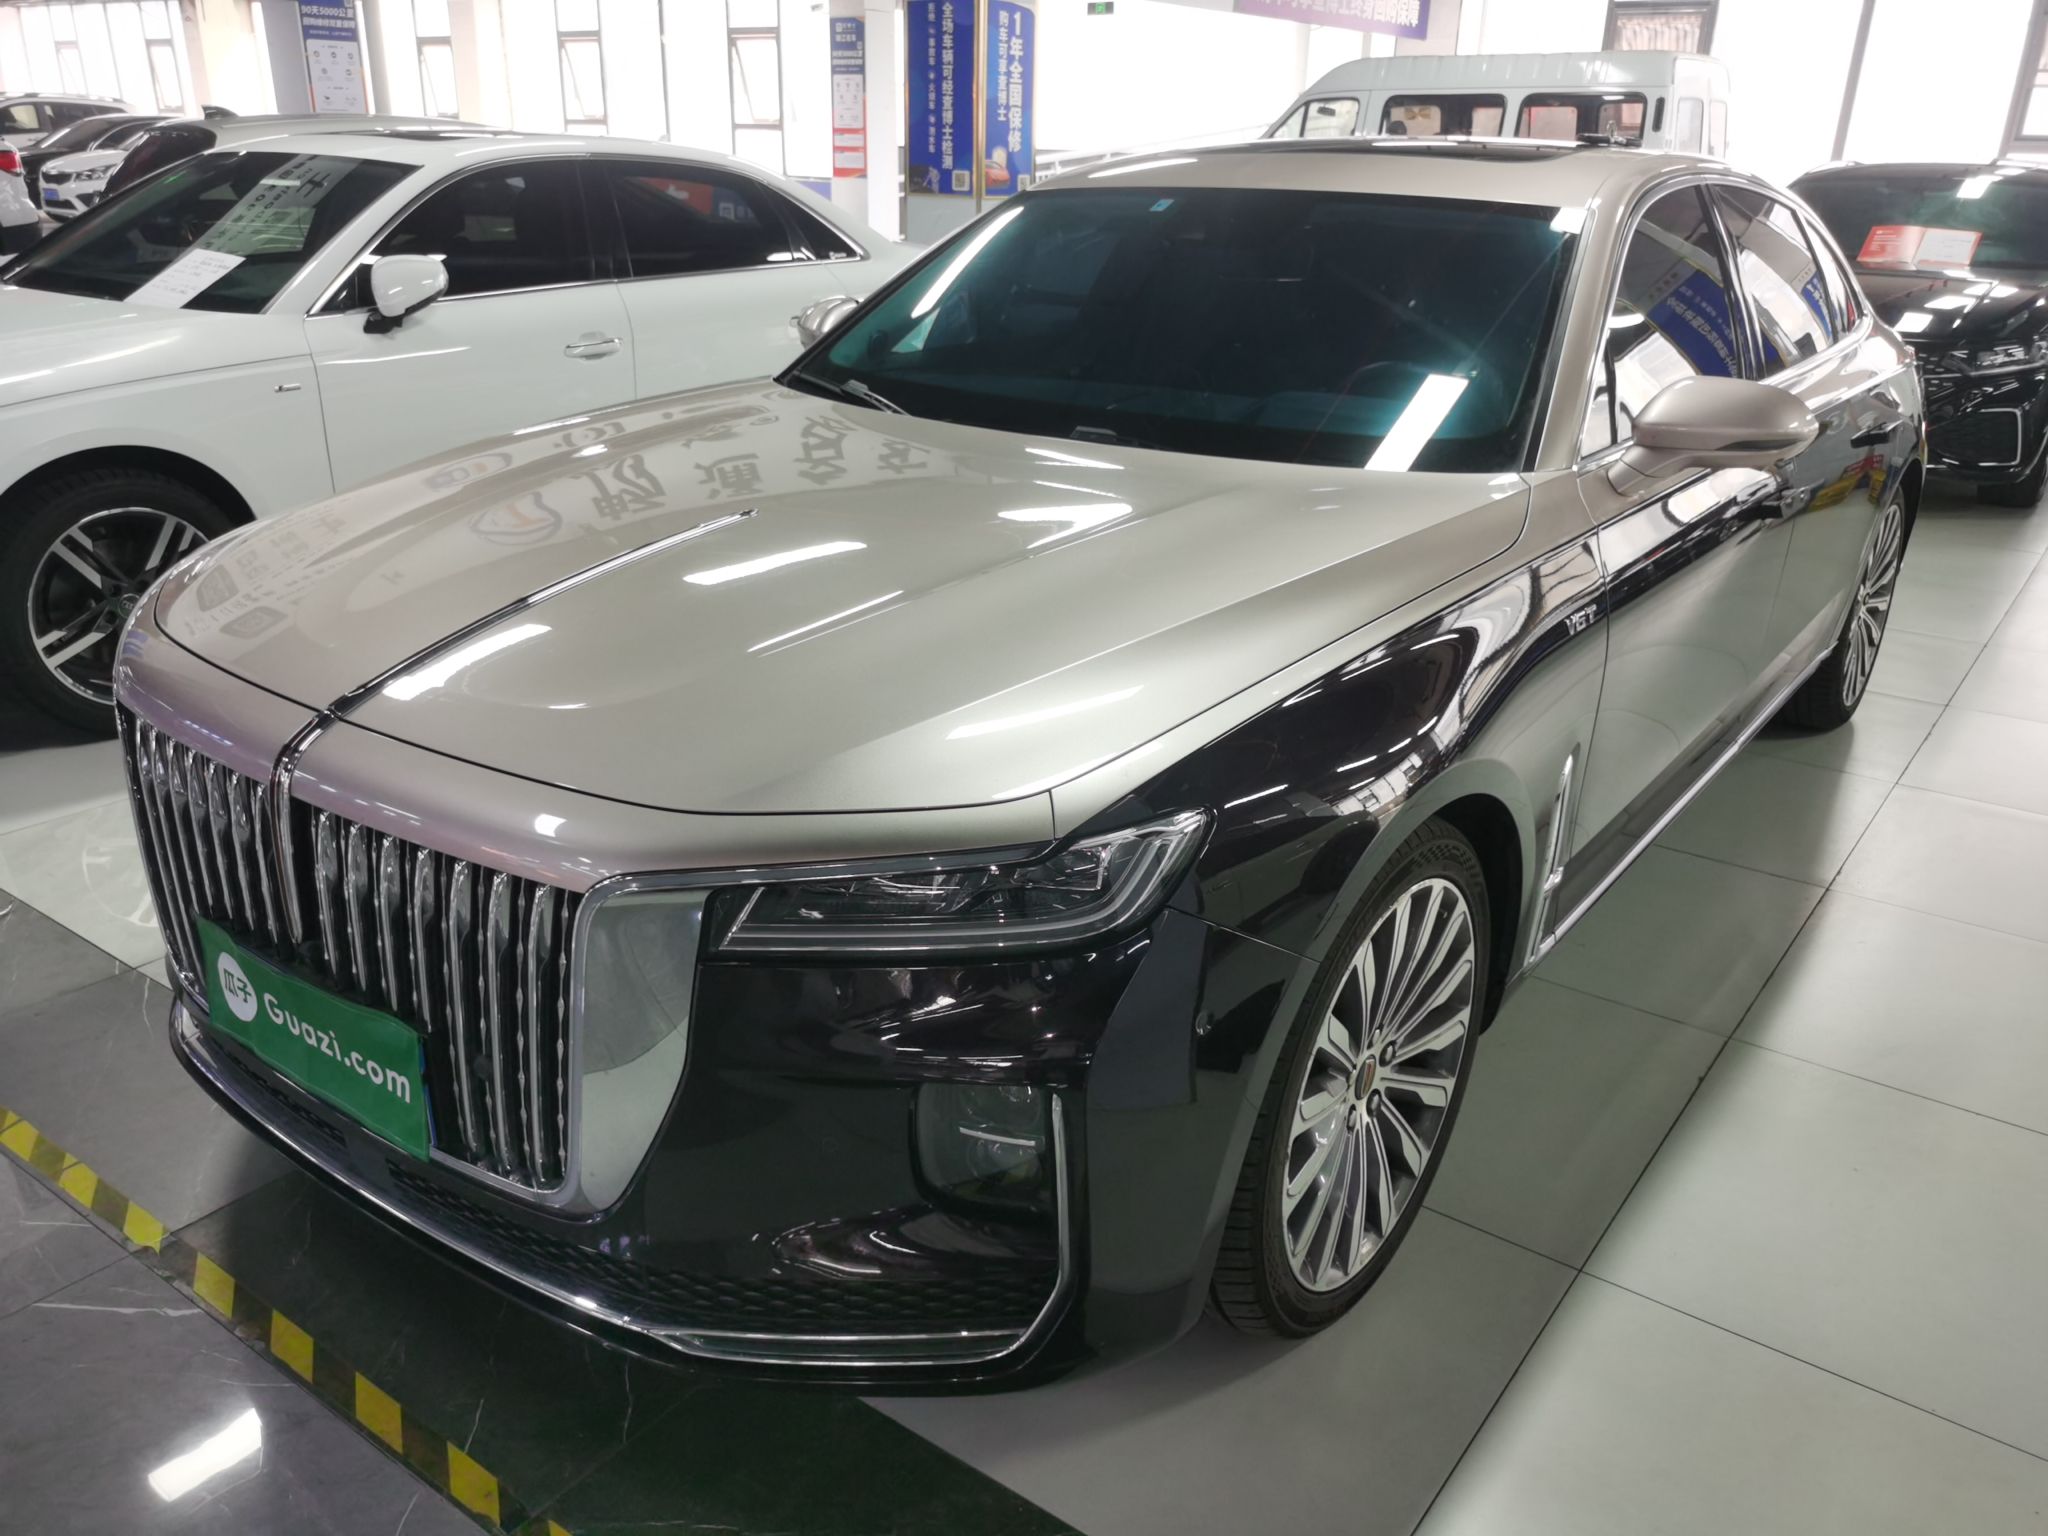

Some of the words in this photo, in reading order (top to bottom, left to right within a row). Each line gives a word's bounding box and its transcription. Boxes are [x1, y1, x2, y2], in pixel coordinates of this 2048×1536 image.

[1008, 11, 1024, 153] 1年全国保修
[222, 968, 252, 1004] 瓜子
[263, 992, 411, 1104] Guazi.com
